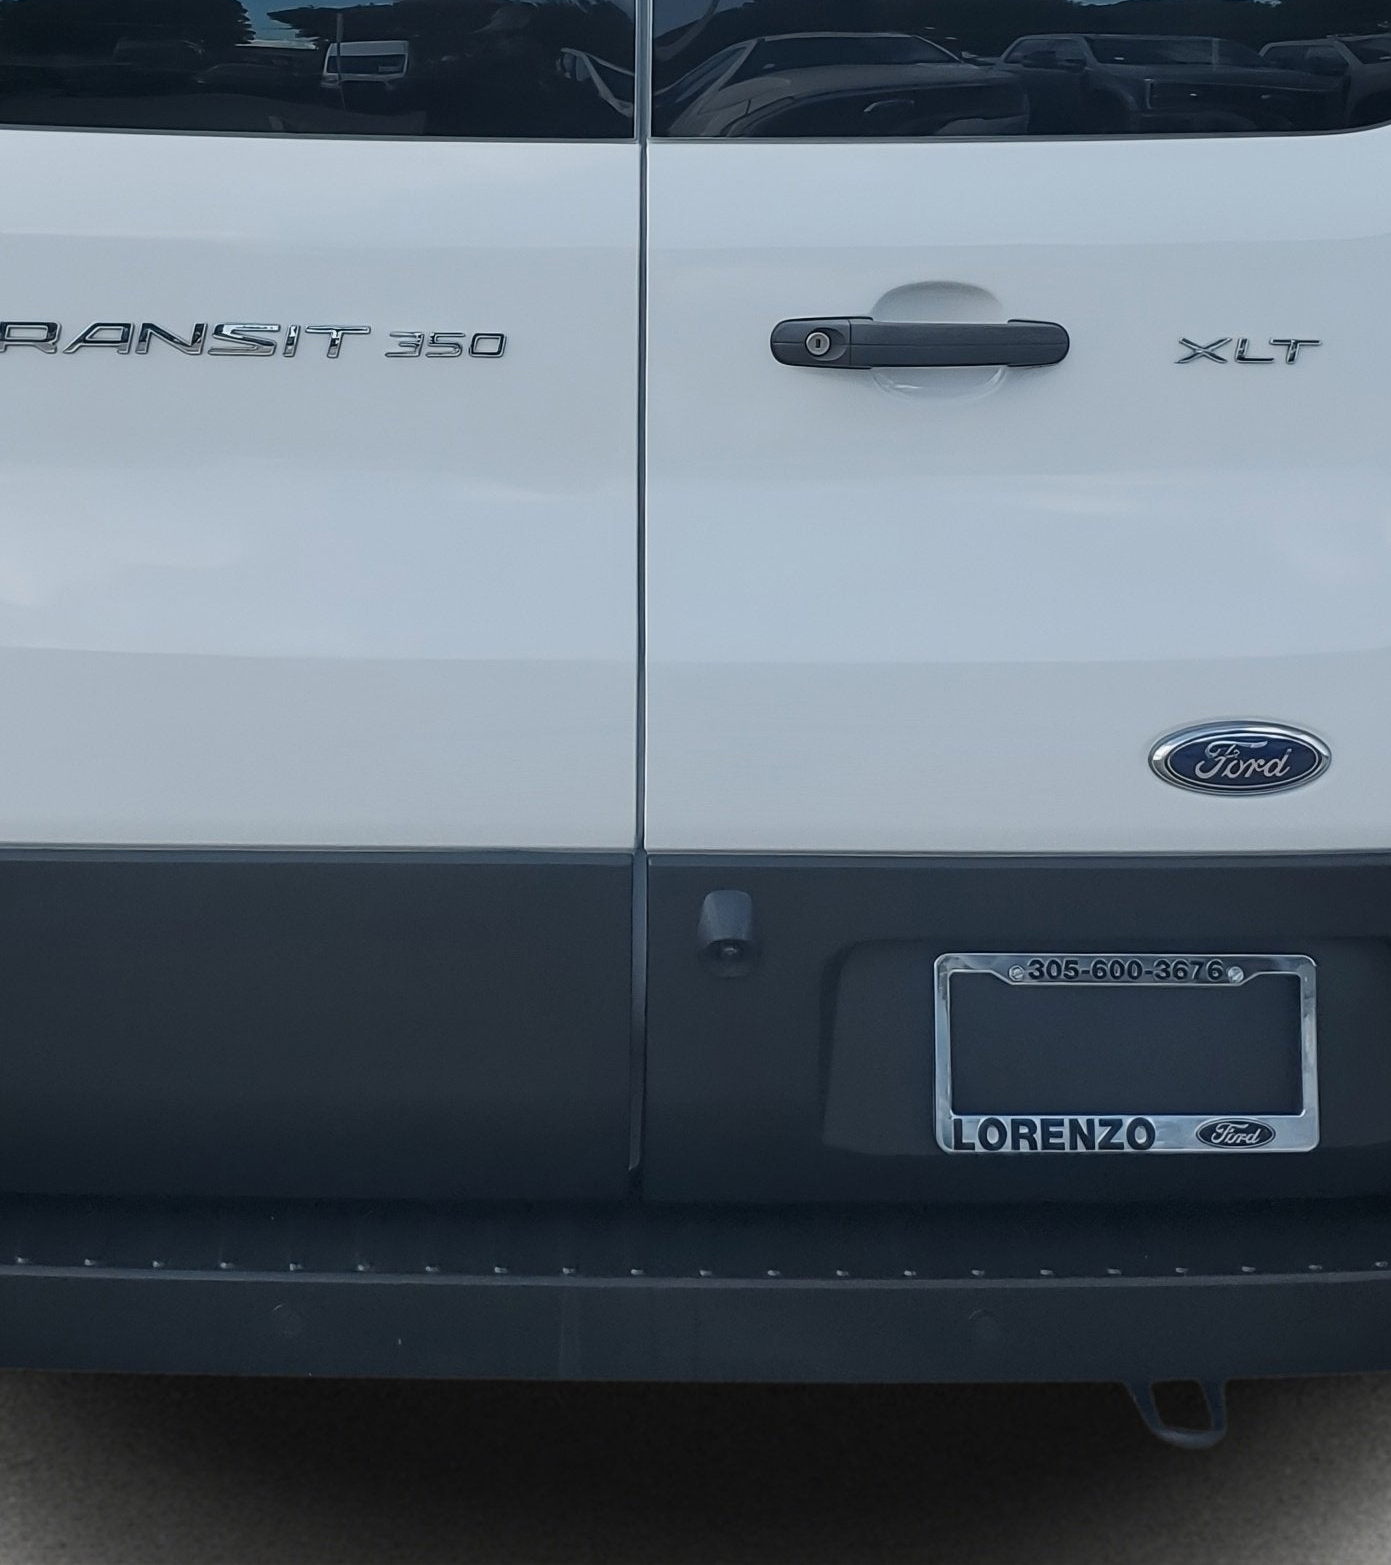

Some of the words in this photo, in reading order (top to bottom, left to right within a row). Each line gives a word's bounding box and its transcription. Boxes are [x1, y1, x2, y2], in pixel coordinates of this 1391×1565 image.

[384, 330, 508, 359] 350
[1174, 337, 1323, 365] XLT
[1194, 740, 1293, 779] Ford
[1027, 959, 1225, 982] 305-600-3676
[952, 1117, 1156, 1151] LORENZO
[1209, 1122, 1263, 1146] Ford
